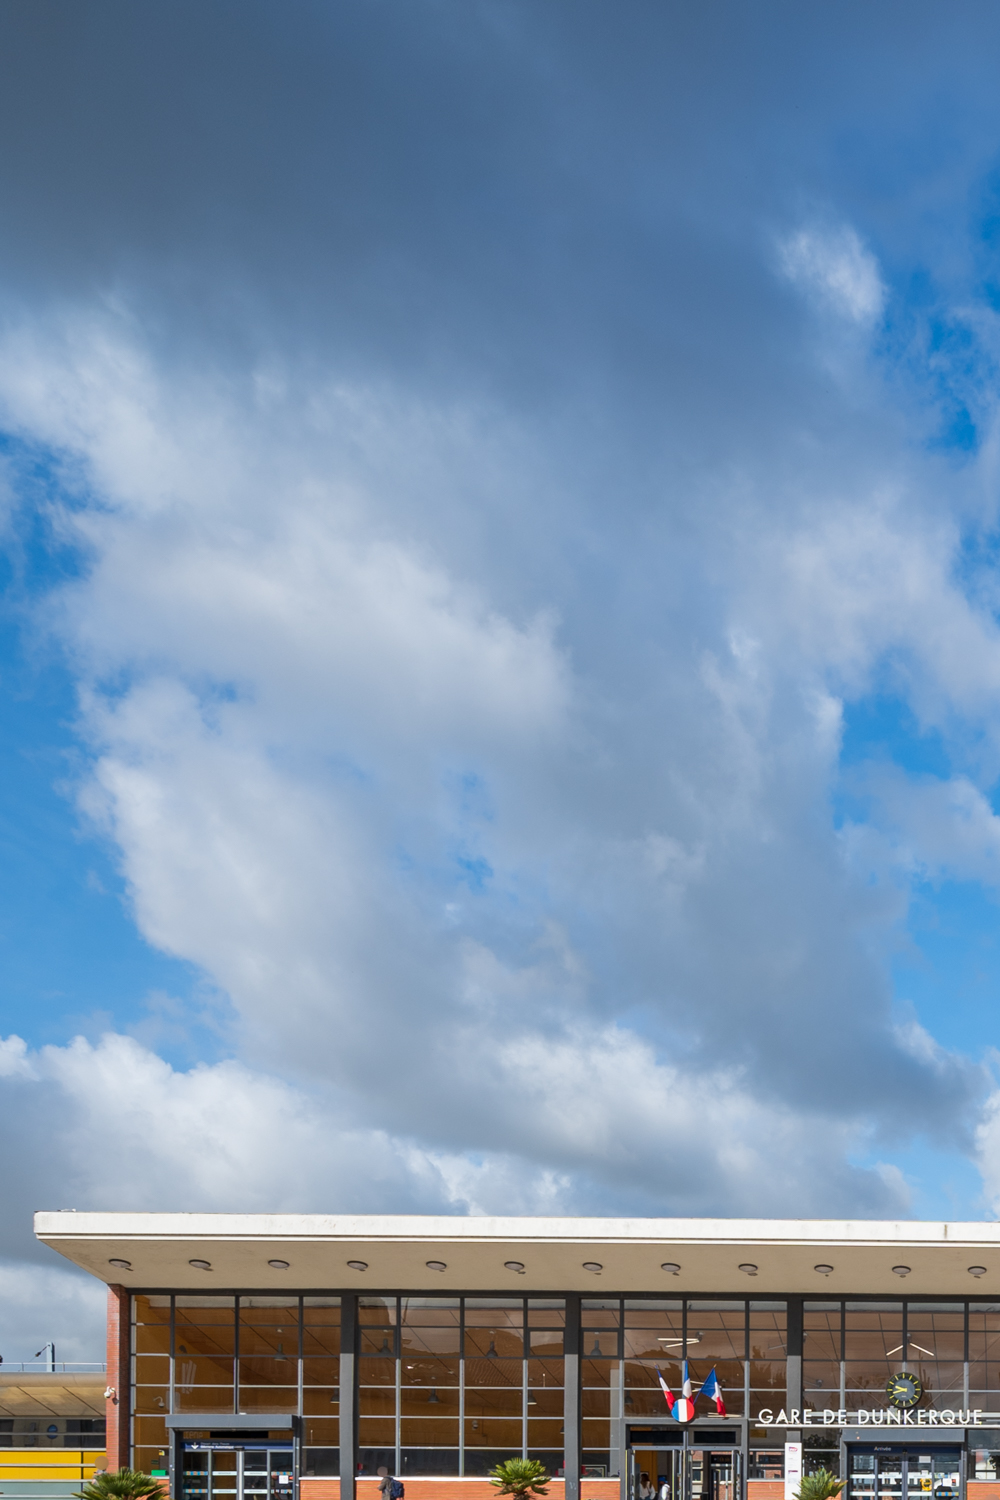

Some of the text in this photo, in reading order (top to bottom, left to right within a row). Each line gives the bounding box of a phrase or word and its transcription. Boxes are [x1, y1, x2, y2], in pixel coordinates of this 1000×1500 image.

[758, 1408, 983, 1425] GARE DE DUNKERQUE
